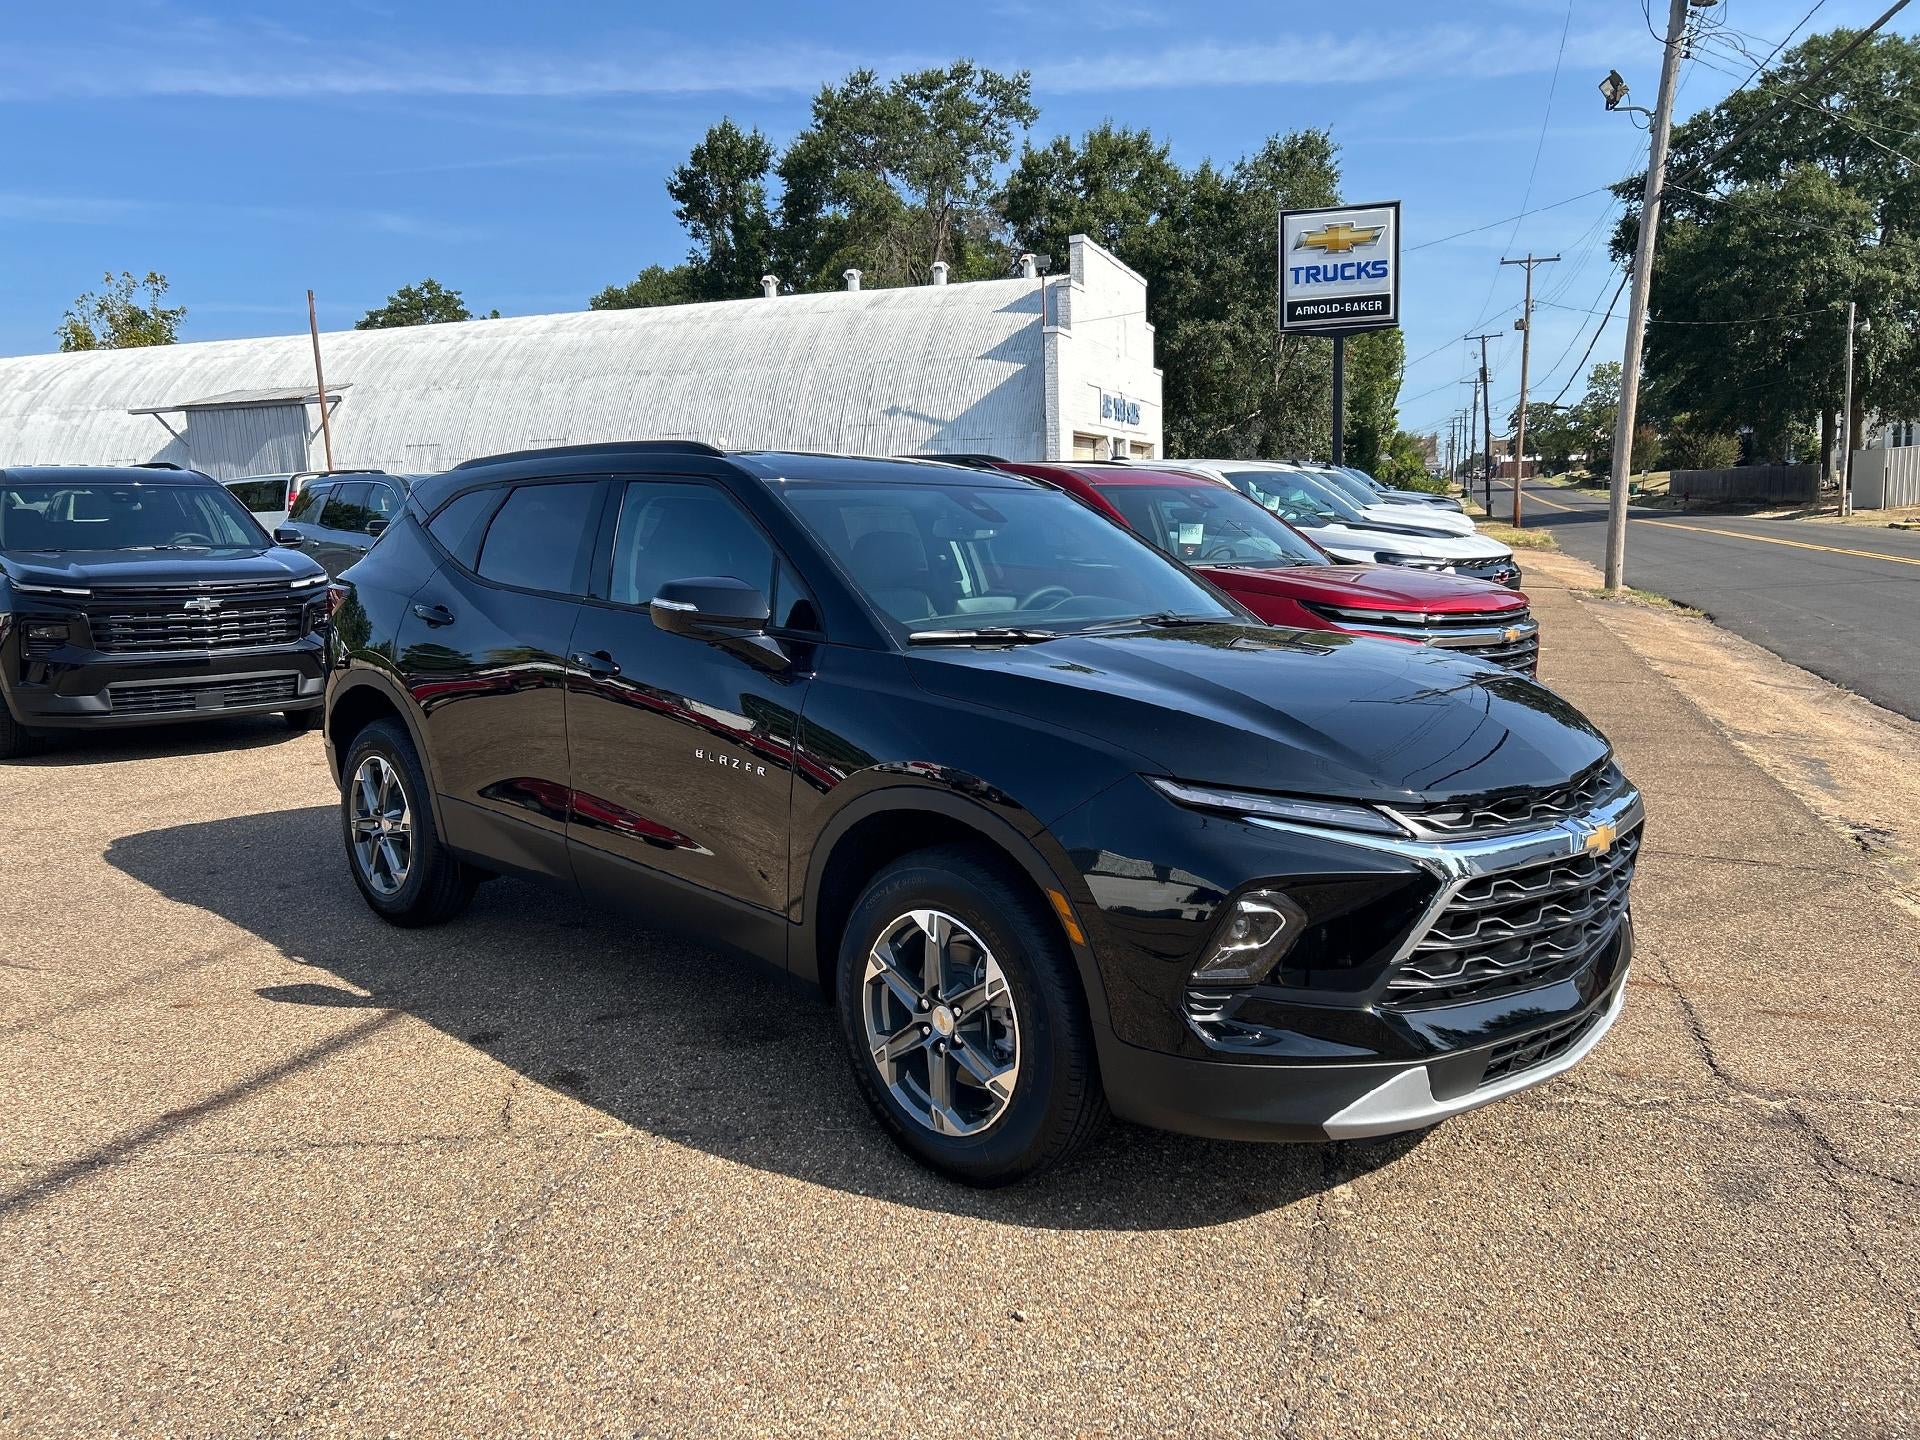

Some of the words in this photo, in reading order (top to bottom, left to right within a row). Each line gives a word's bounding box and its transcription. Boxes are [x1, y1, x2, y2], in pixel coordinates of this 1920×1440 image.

[1290, 260, 1388, 285] TRUCKS
[1295, 301, 1383, 316] ARNOLD-BAKER
[695, 748, 766, 777] BLAZER
